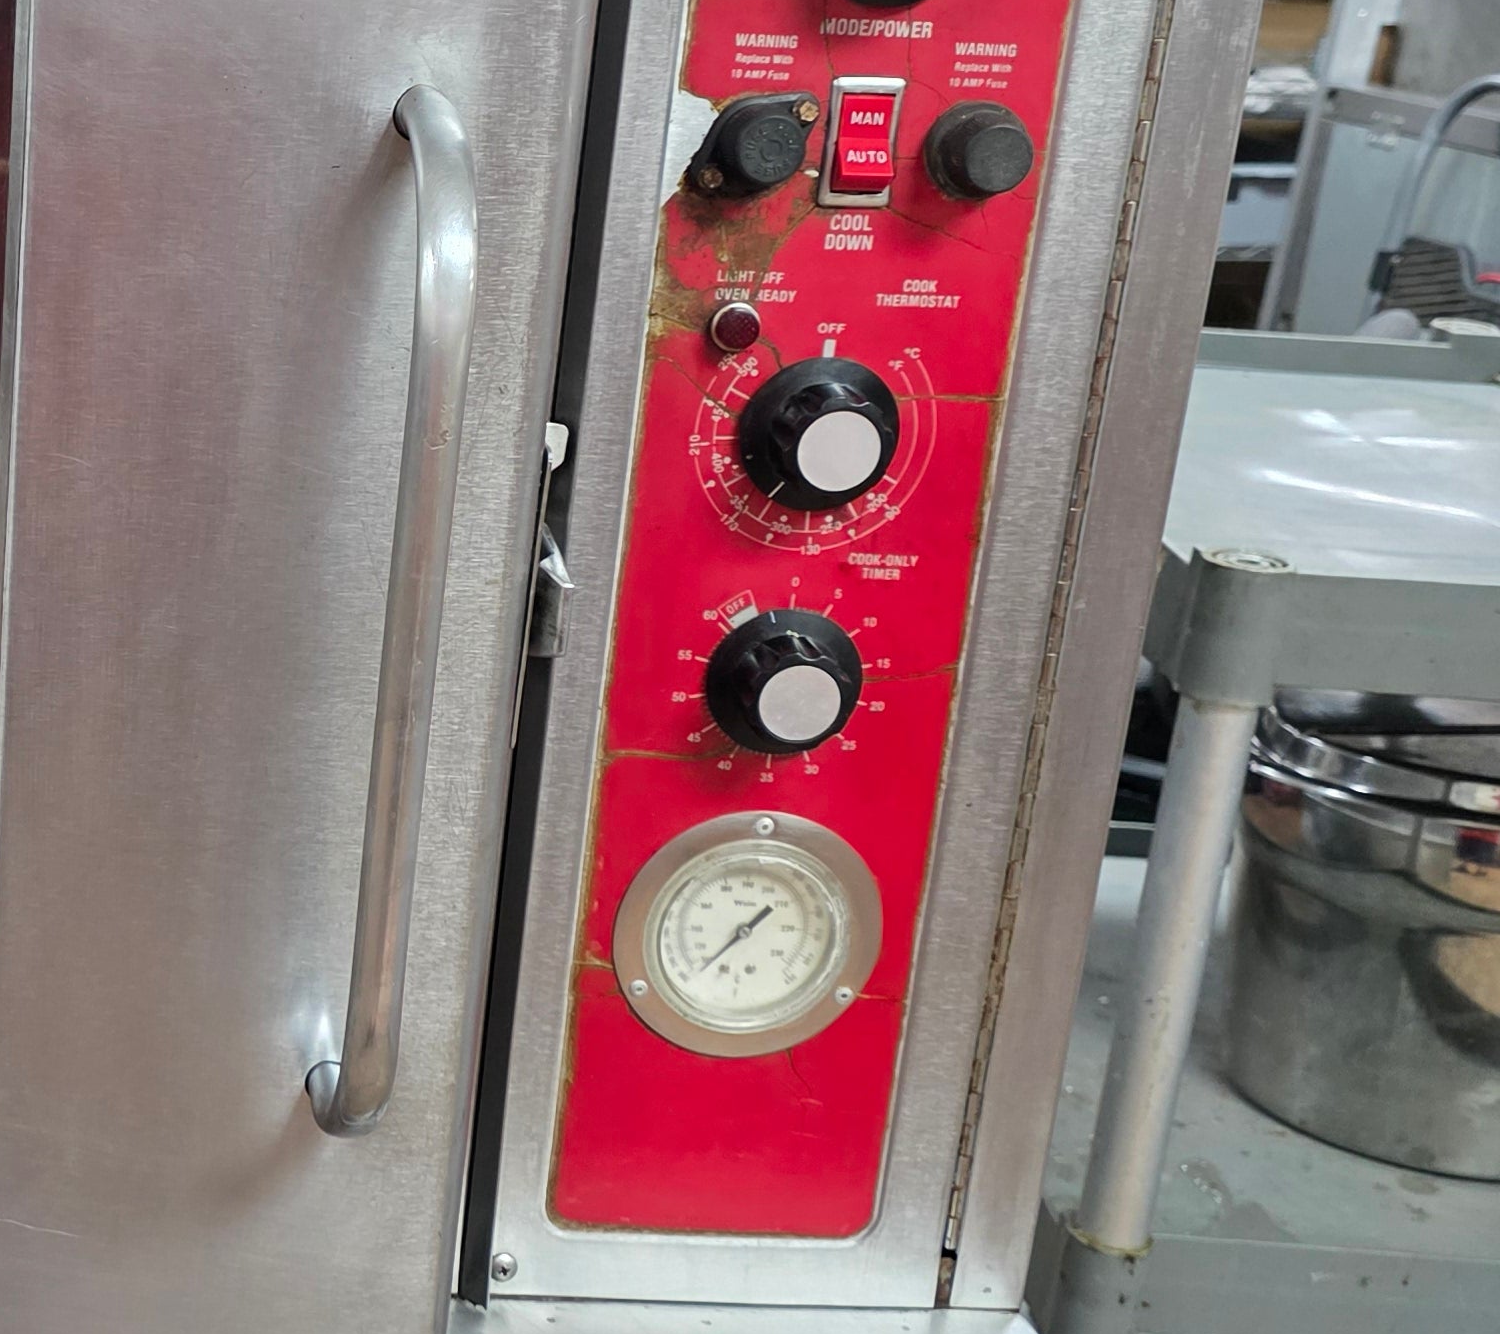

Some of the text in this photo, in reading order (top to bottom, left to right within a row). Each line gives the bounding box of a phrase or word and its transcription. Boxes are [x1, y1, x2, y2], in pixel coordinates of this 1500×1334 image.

[820, 18, 933, 38] MODE/POWER
[735, 33, 798, 49] WARNING
[955, 42, 1017, 57] WARNING
[735, 53, 794, 64] Replace With
[954, 62, 1012, 73] Replace With
[744, 70, 766, 79] AMP
[768, 70, 789, 80] Fuse
[962, 78, 983, 87] AMP
[985, 79, 1008, 89] Fuse
[850, 111, 885, 126] MAN
[847, 151, 887, 163] AUTO
[829, 214, 873, 231] COOL
[823, 233, 874, 250] DOWN
[903, 279, 938, 293] COOK
[715, 288, 750, 300] OVEN
[876, 293, 961, 308] THERMOSTAT
[817, 323, 846, 334] OFF
[737, 356, 758, 377] 500
[688, 435, 700, 456] 210
[711, 453, 725, 473] 400
[720, 513, 739, 531] 170
[770, 521, 792, 534] 300
[800, 544, 820, 555] 130
[848, 552, 919, 567] COOK-ONLY
[862, 567, 901, 580] TIMER
[791, 577, 800, 587] 0
[834, 589, 843, 599] 5
[726, 598, 745, 615] OFF
[703, 610, 718, 620] 60
[863, 617, 877, 627] 10
[677, 650, 692, 660] 55
[877, 659, 891, 669] 15
[671, 692, 686, 702] 50
[869, 701, 885, 712] 20
[686, 732, 701, 743] 45
[841, 740, 857, 750] 25
[717, 760, 732, 770] 40
[804, 764, 819, 775] 30
[760, 773, 774, 783] 35
